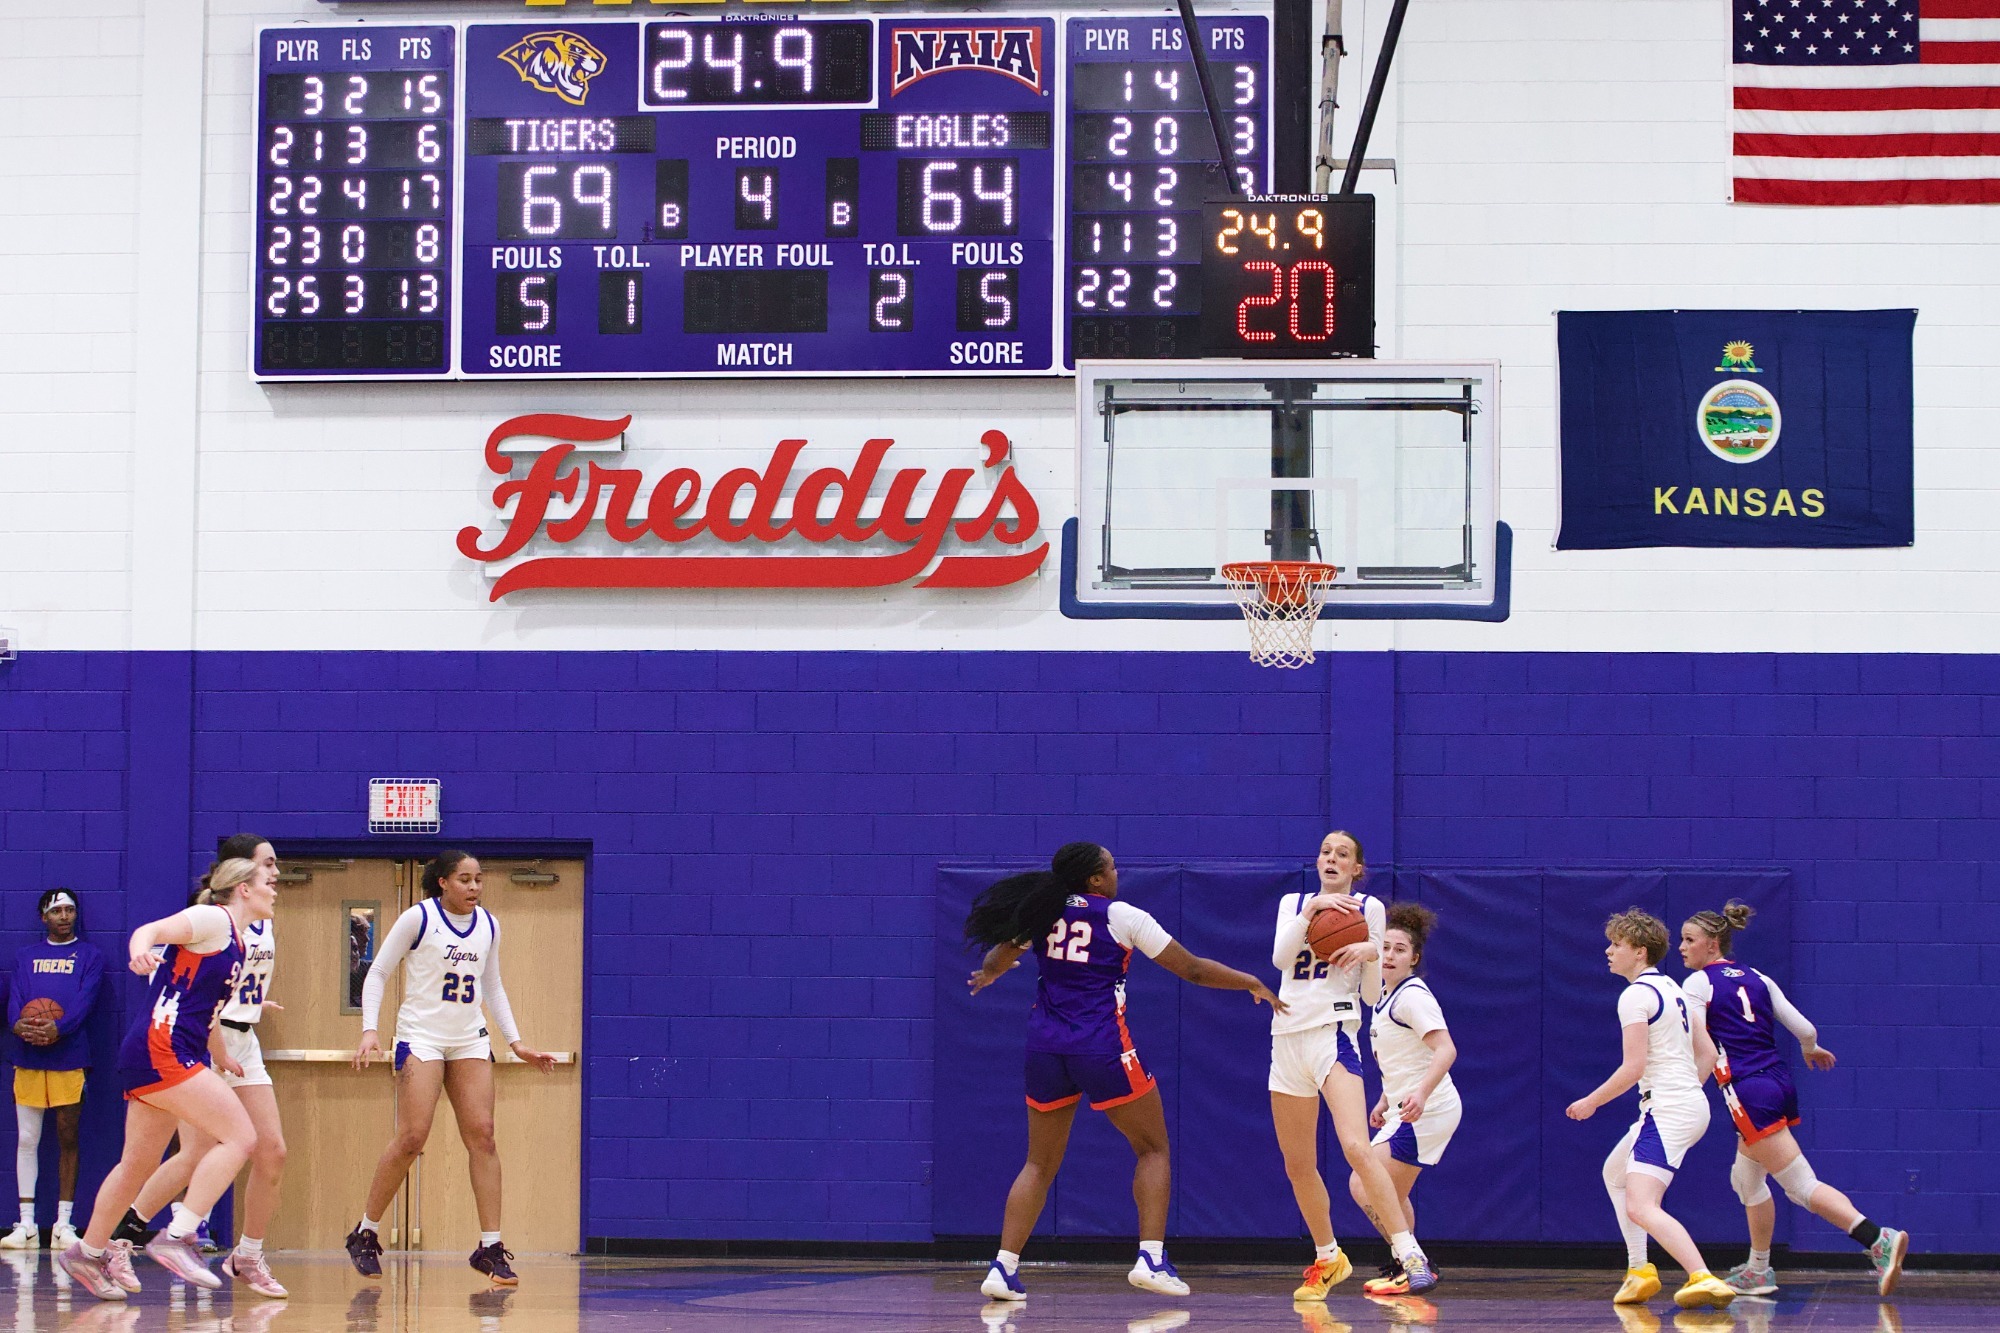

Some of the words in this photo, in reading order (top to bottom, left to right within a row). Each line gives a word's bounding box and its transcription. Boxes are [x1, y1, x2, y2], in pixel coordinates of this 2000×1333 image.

[725, 14, 794, 22] DAKTRONICS
[277, 40, 318, 61] PLYR
[343, 39, 371, 60] FLS
[400, 38, 430, 59] PTS
[1086, 29, 1128, 50] PLYR
[1153, 29, 1181, 50] FLS
[1213, 28, 1244, 49] PTS
[655, 29, 812, 97] 24.9
[894, 29, 1039, 90] NAIA
[305, 78, 323, 114] 3
[345, 77, 367, 114] 2
[405, 76, 440, 113] 15
[1125, 71, 1132, 101] 1
[1155, 71, 1177, 100] 4
[1235, 66, 1254, 104] 3
[271, 128, 322, 164] 21
[348, 127, 366, 163] 3
[418, 125, 439, 162] 6
[506, 120, 614, 151] TIGERS
[717, 137, 795, 158] PERIOD
[898, 115, 1008, 147] EAGLES
[1109, 118, 1131, 155] 2
[1155, 117, 1177, 155] 0
[1235, 117, 1253, 154] 3
[271, 177, 321, 214] 22
[344, 180, 365, 209] 4
[404, 175, 439, 208] 17
[524, 166, 610, 234] 69
[742, 176, 772, 220] 4
[924, 163, 1012, 230] 64
[1109, 172, 1131, 202] 4
[1155, 168, 1176, 205] 2
[664, 204, 679, 226] B
[834, 203, 849, 224] B
[1218, 210, 1322, 253] 24.9
[270, 227, 320, 264] 23
[343, 226, 364, 262] 0
[417, 225, 438, 262] 8
[682, 246, 762, 266] PLAYER
[778, 245, 833, 265] FOUL
[864, 244, 919, 265] T.O.L.
[953, 243, 1022, 264] FOULS
[1094, 223, 1130, 252] 11
[1158, 219, 1176, 256] 3
[493, 247, 561, 268] FOULS
[594, 246, 649, 267] T.O.L.
[269, 276, 319, 313] 25
[346, 276, 363, 312] 3
[402, 275, 437, 312] 13
[521, 277, 548, 328] 5
[877, 274, 905, 326] 2
[982, 274, 1010, 325] 5
[1078, 270, 1130, 307] 22
[1154, 270, 1176, 306] 2
[1238, 261, 1334, 341] 20
[490, 346, 560, 367] SCORE
[718, 344, 791, 365] MATCH
[951, 342, 1022, 363] SCORE
[456, 414, 1049, 602] Freddy's
[1654, 486, 1825, 517] KANSAS
[386, 786, 426, 818] EXIT
[248, 944, 273, 967] Tigers
[444, 944, 478, 966] Tigers
[1047, 918, 1092, 963] 22
[33, 959, 75, 974] TIGERS
[240, 973, 267, 1004] 25
[442, 972, 475, 1004] 23
[1736, 986, 1756, 1022] 1
[1676, 997, 1689, 1033] 3
